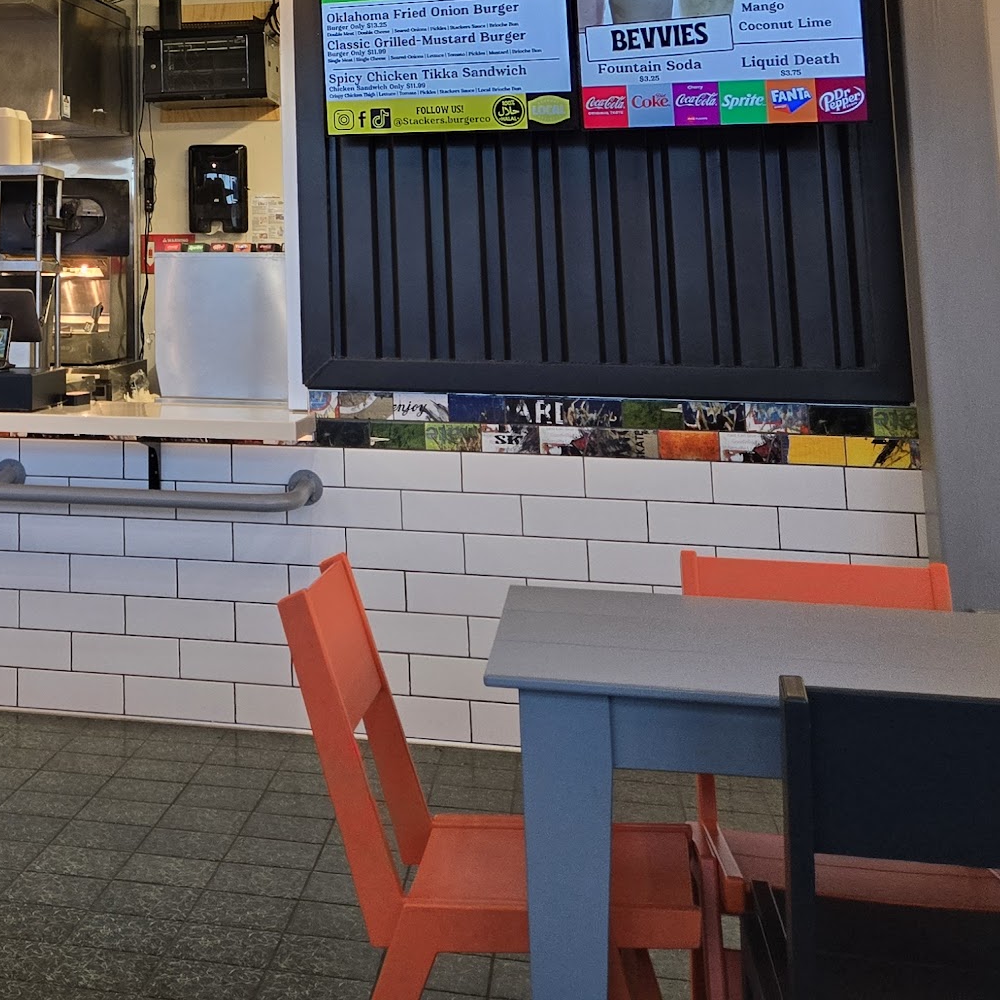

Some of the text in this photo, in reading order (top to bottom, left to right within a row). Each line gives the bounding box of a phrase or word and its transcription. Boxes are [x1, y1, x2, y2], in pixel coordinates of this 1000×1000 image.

[327, 3, 519, 23] Oklahoma Fried Onion Burger
[742, 2, 784, 13] Mango
[739, 18, 832, 30] Coconut Lime
[328, 31, 526, 50] Classic Grilled-Mustard Burger
[611, 22, 708, 51] BEVVIES
[598, 59, 702, 73] Fountain Soda
[742, 53, 840, 70] Liquid Death
[329, 65, 526, 86] Spicy Chicken Tikka Sandwich
[357, 83, 387, 91] Sandwich
[771, 87, 811, 102] FANTA
[836, 88, 850, 98] Dr
[632, 94, 670, 109] Coke
[722, 94, 765, 109] Sprite
[824, 91, 862, 112] Pepper
[416, 105, 464, 114] FOLLOW US!
[393, 116, 490, 127] @Stackers.burgerco
